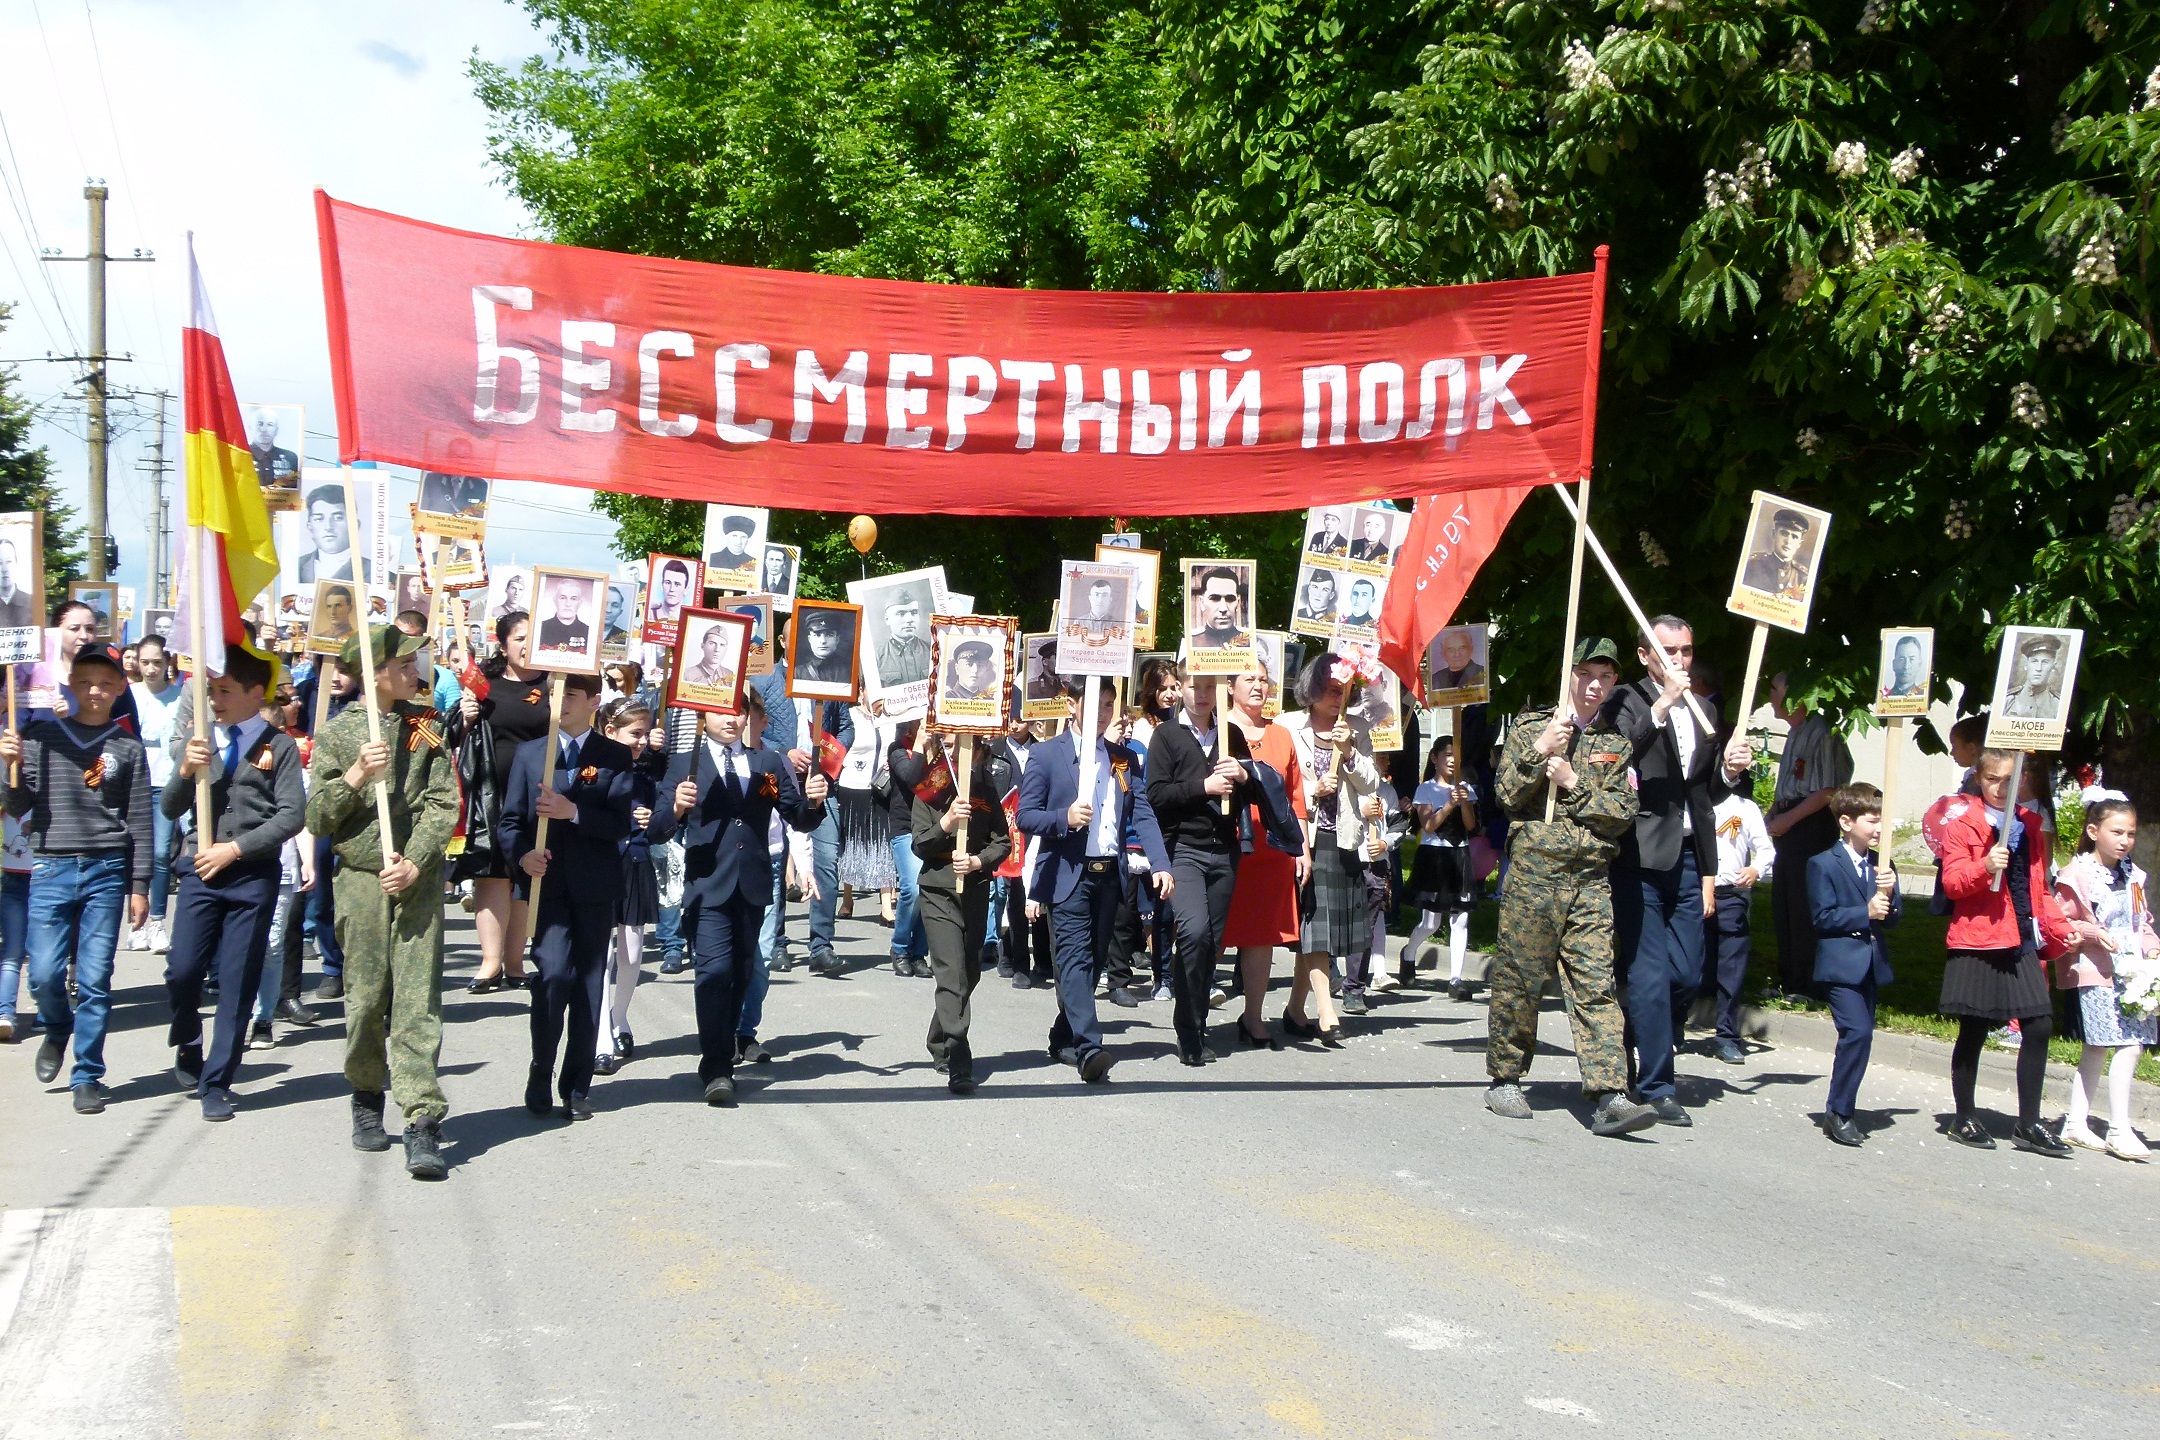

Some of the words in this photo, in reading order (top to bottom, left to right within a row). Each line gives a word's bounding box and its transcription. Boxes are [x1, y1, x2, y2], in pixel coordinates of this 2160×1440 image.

[471, 285, 1261, 455] БЕССМЕРТНЫЙ
[1301, 353, 1533, 449] ПОЛК
[376, 510, 385, 584] БЕССМЕРТНЫЙ
[1086, 566, 1120, 575] БЕССМЕРТНЫЙ
[910, 691, 928, 701] Куба
[2010, 720, 2045, 730] ТАКОЕВ
